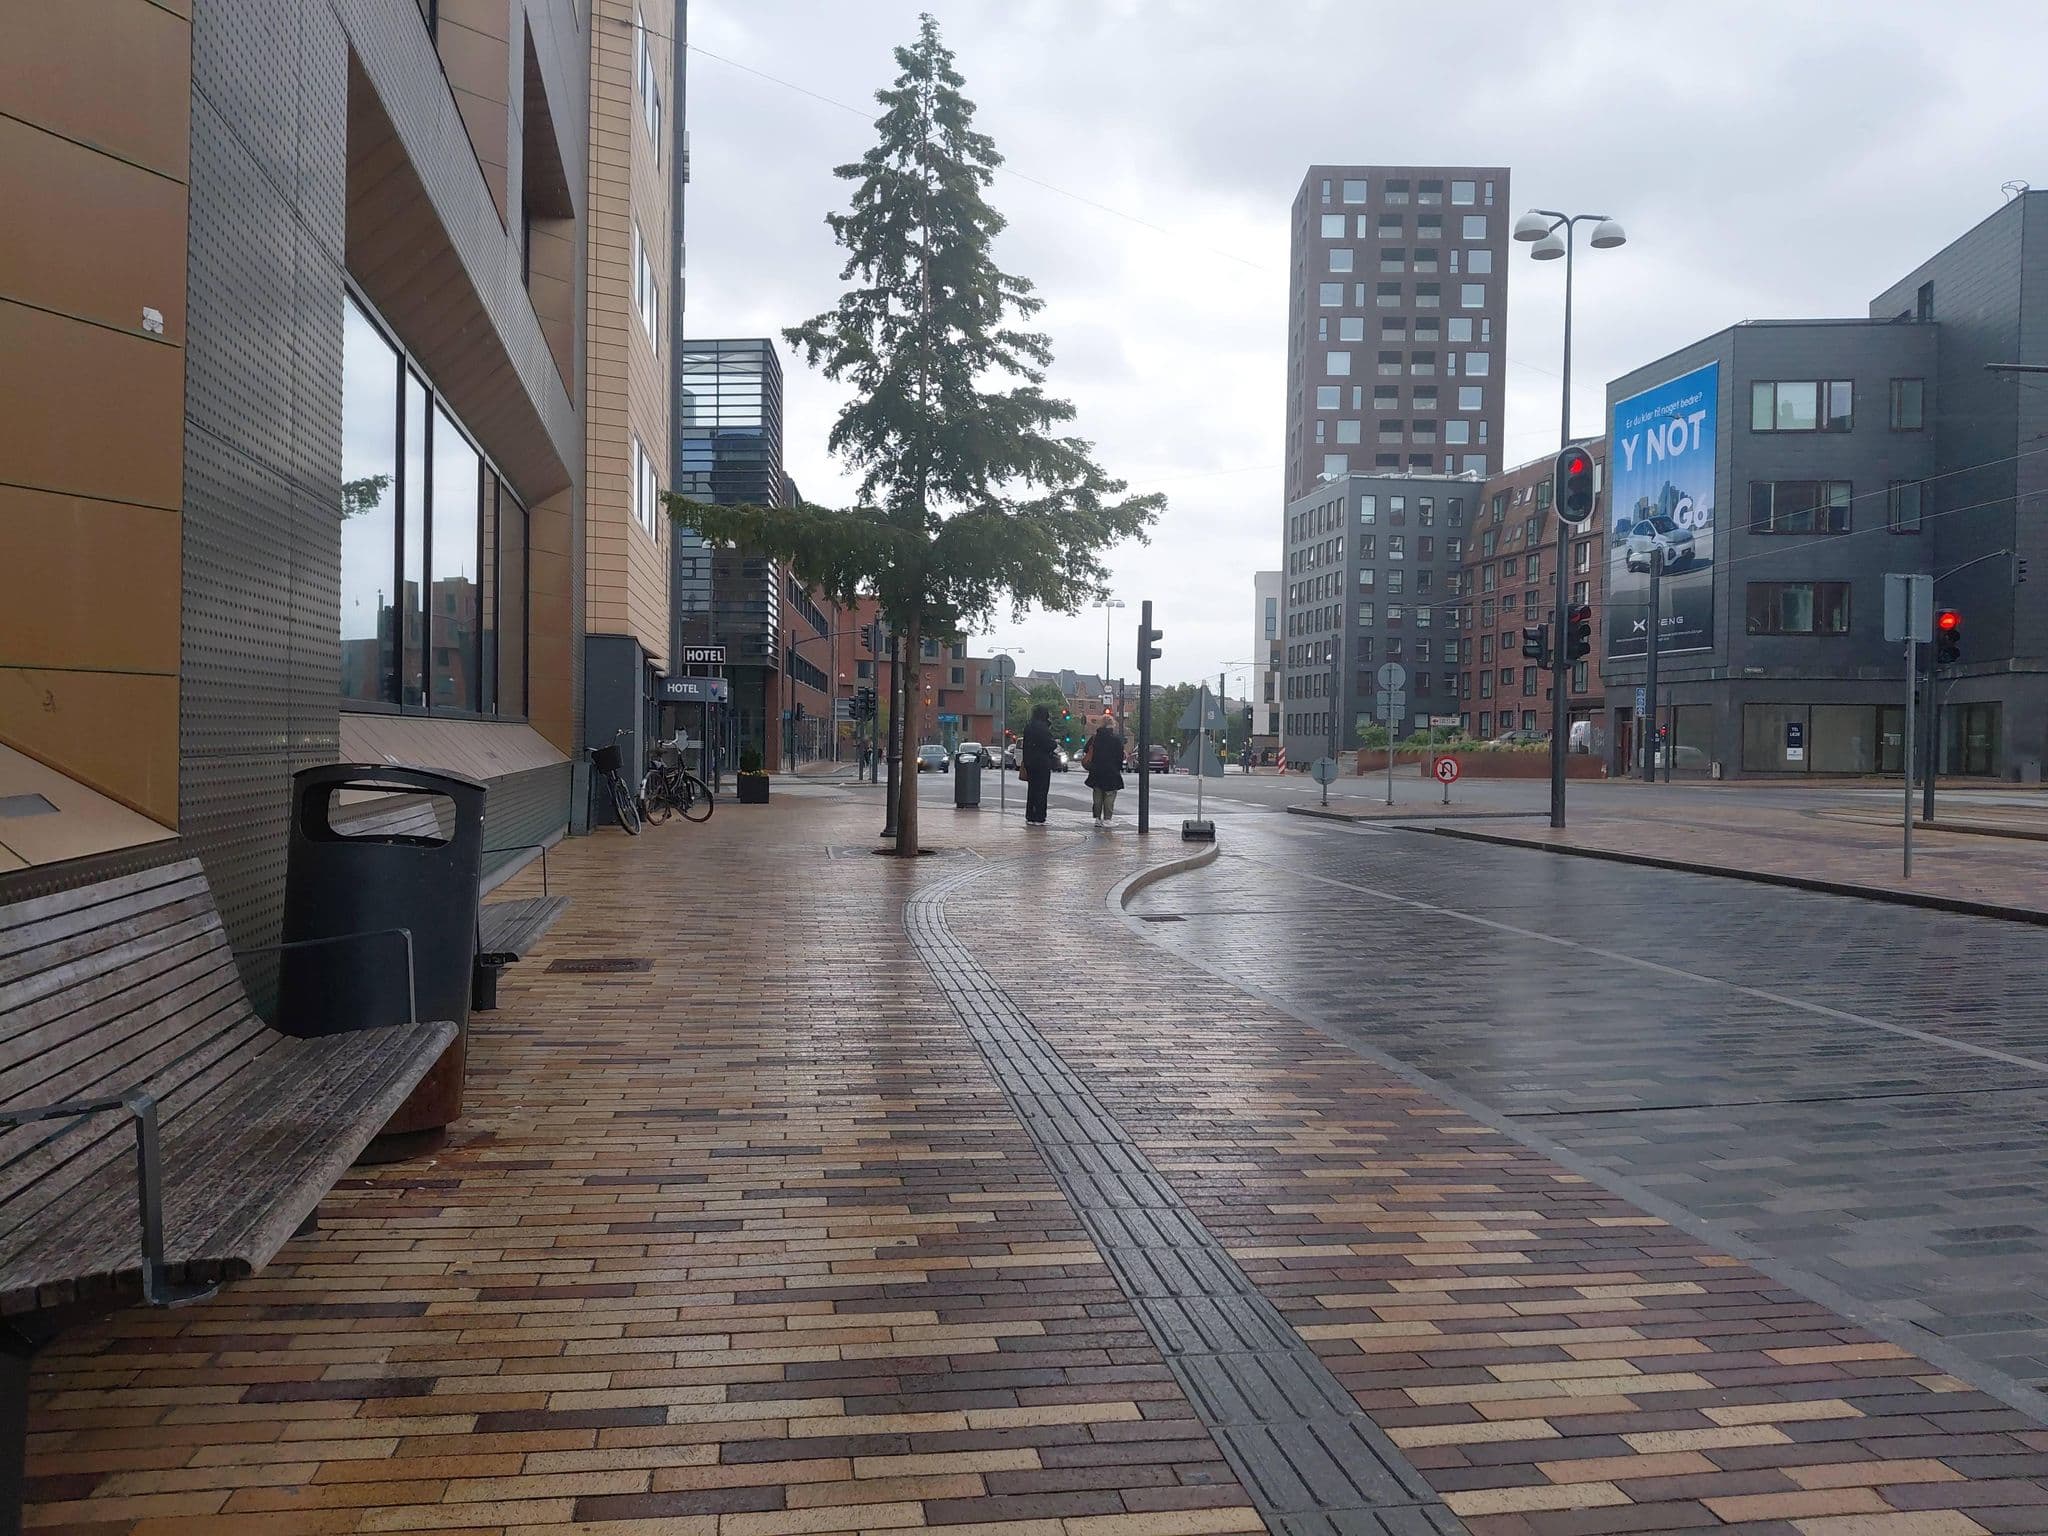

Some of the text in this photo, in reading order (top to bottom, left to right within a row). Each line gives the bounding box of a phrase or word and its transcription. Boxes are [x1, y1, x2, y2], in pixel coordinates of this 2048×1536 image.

[1626, 419, 1633, 429] Er
[1634, 415, 1640, 426] du
[1641, 410, 1653, 423] klar
[1661, 401, 1679, 415] noget
[1680, 392, 1702, 408] bedre?
[1621, 409, 1706, 472] Y NOT
[1632, 616, 1684, 633] XENG
[686, 650, 724, 662] HOTEL
[667, 683, 699, 694] HOTEL
